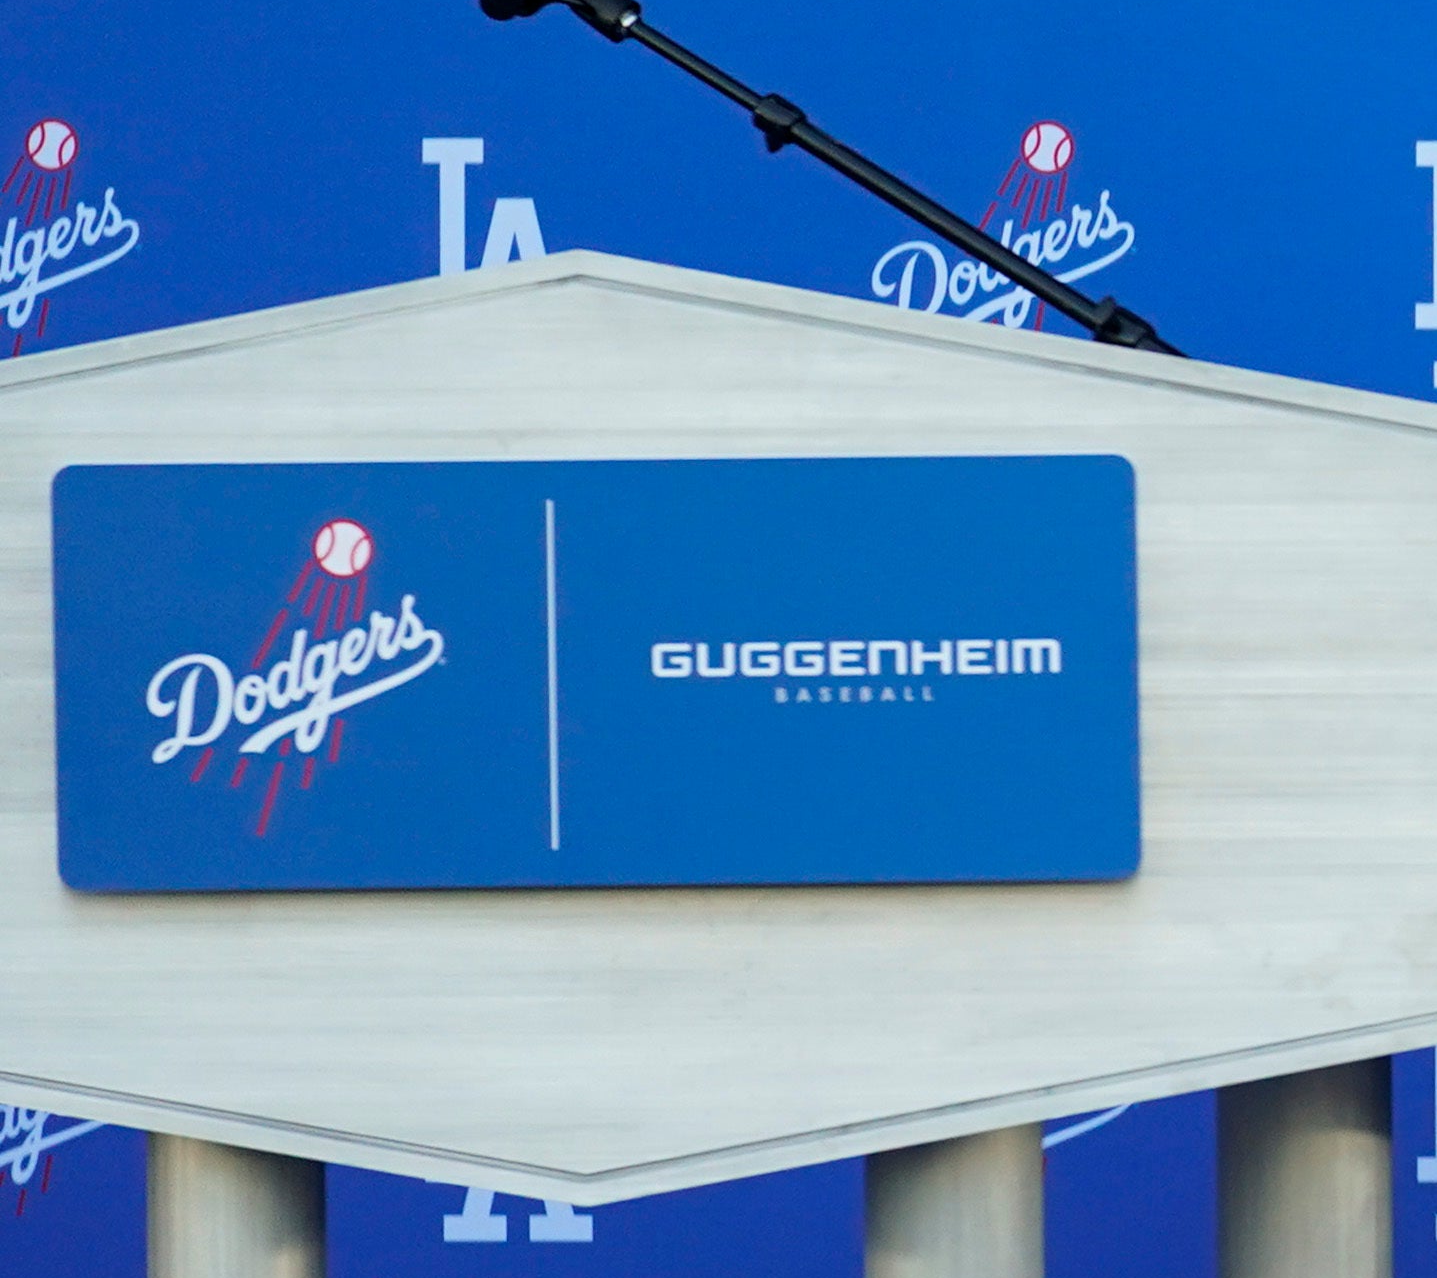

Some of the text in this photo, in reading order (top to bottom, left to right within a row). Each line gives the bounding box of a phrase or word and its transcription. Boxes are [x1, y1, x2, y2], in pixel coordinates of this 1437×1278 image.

[651, 638, 1062, 678] GUGGENHEIM
[146, 594, 445, 764] Dodgers
[774, 685, 933, 704] BASEBALL
